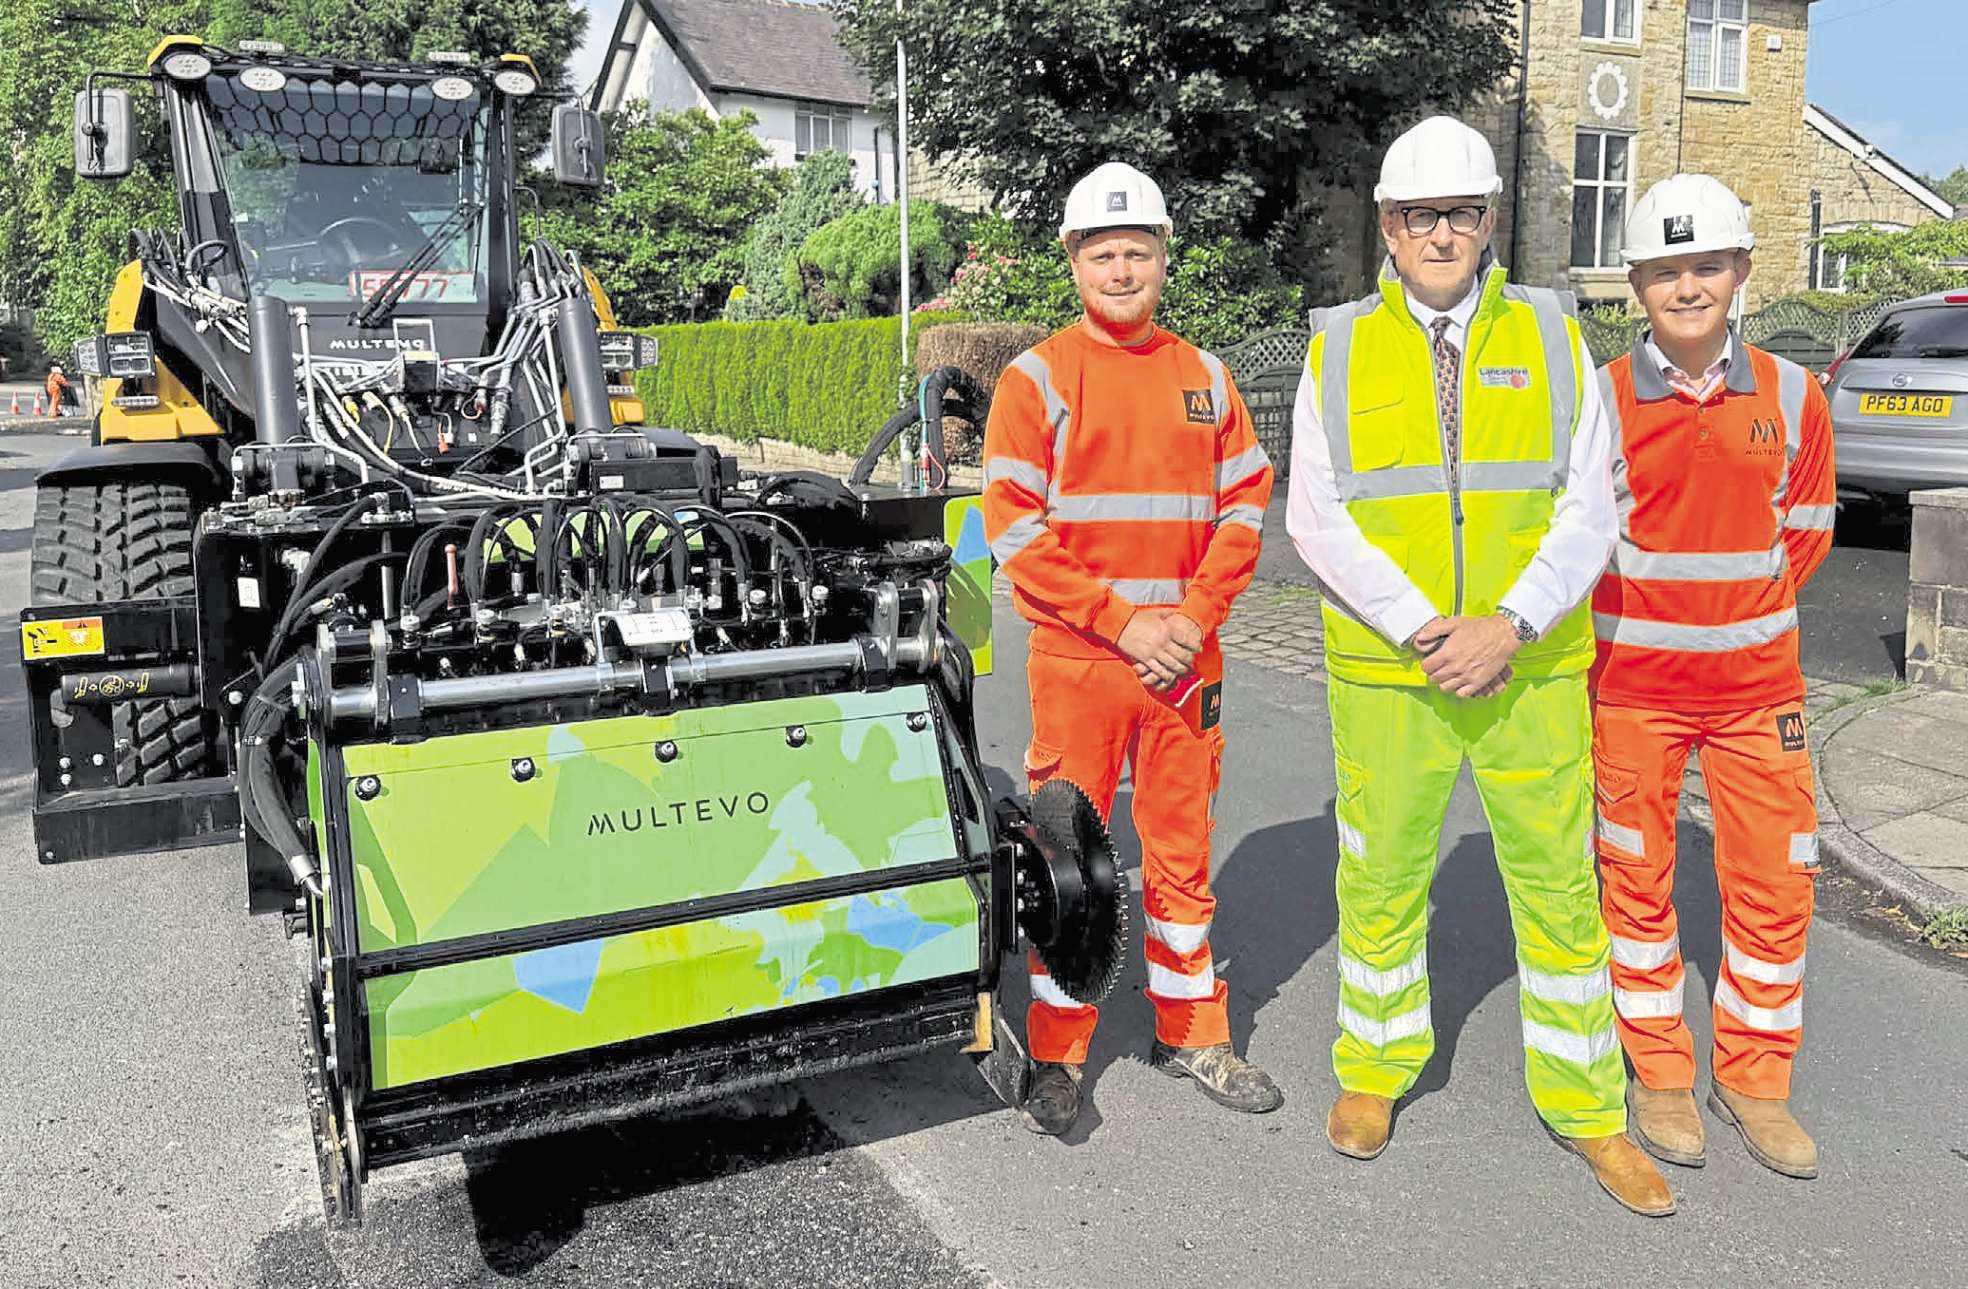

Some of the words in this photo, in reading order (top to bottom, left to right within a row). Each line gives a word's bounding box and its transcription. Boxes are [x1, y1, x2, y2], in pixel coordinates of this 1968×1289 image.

[1866, 395, 1907, 411] PF63
[1911, 397, 1944, 413] AGO
[588, 791, 769, 836] MULTEVO
